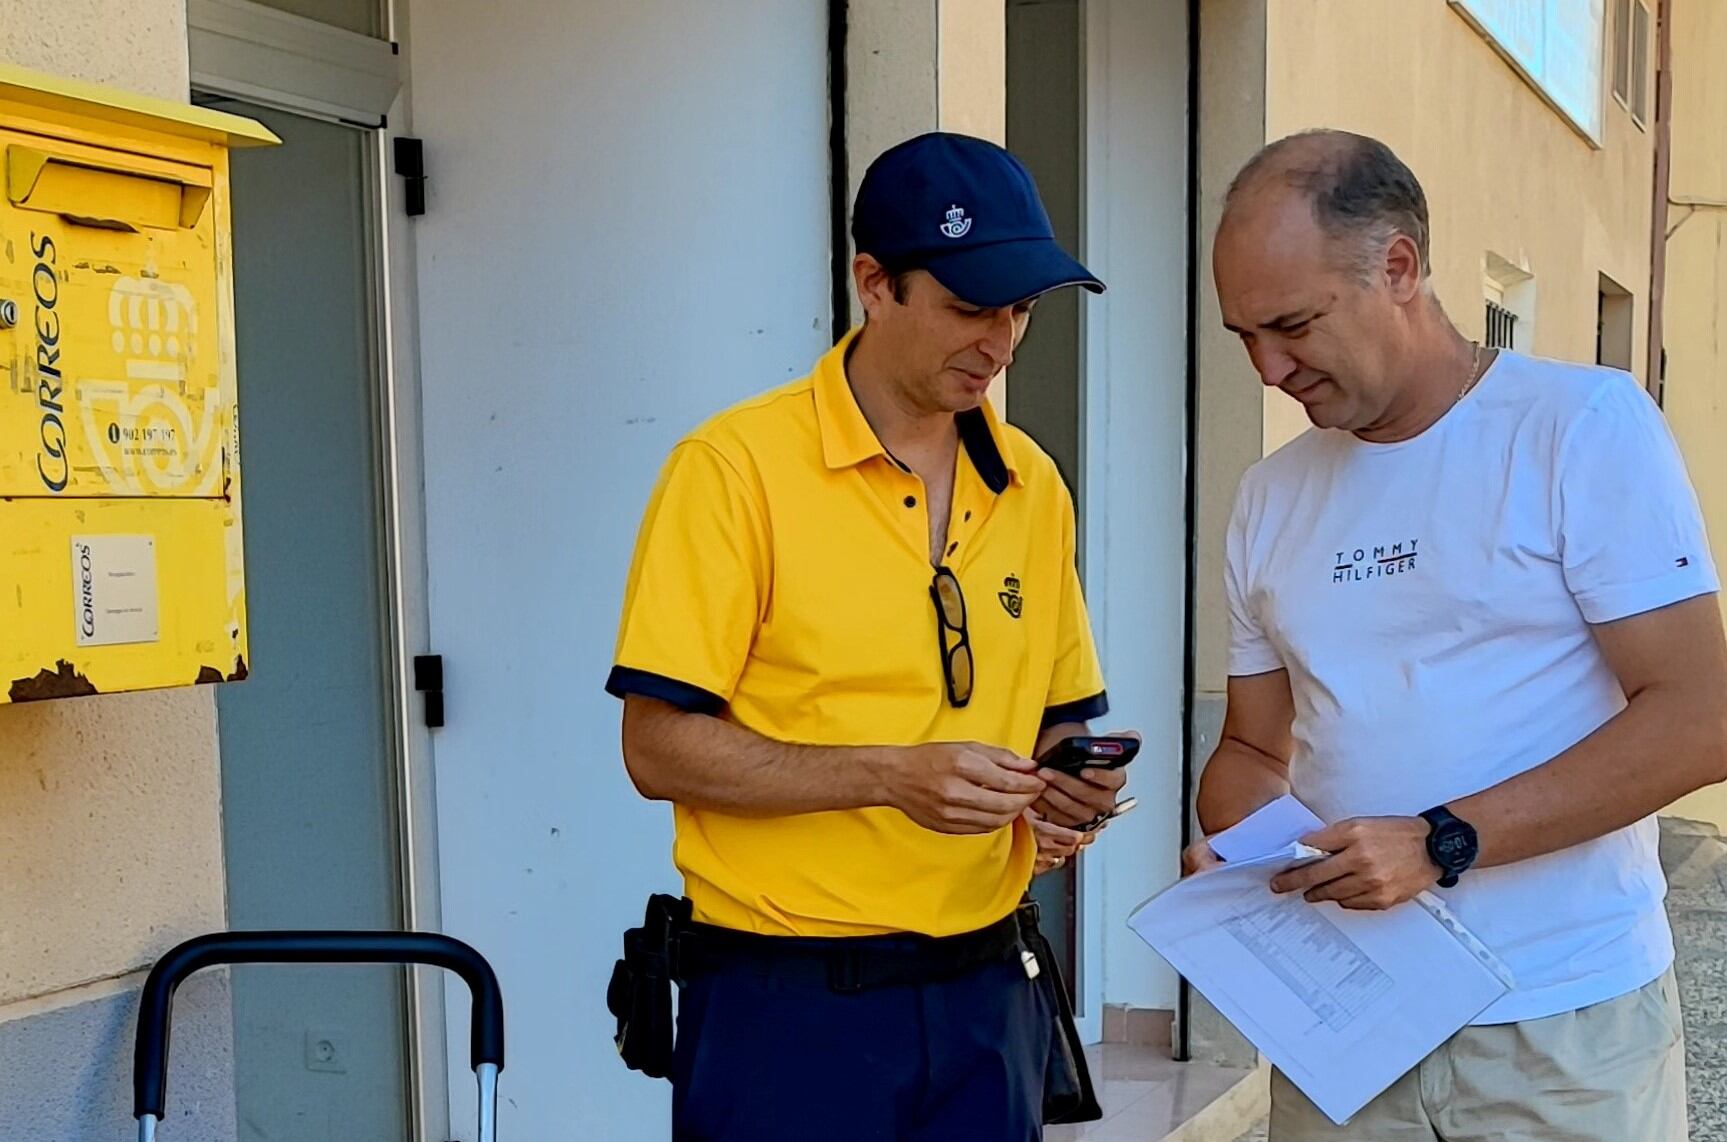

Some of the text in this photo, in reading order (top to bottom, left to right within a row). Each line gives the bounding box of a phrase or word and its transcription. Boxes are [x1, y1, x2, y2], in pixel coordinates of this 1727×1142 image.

[30, 231, 68, 492] CORREOS
[1333, 558, 1415, 583] HILFIGER
[1336, 539, 1418, 564] TOMMY
[81, 545, 94, 637] CORREOS
